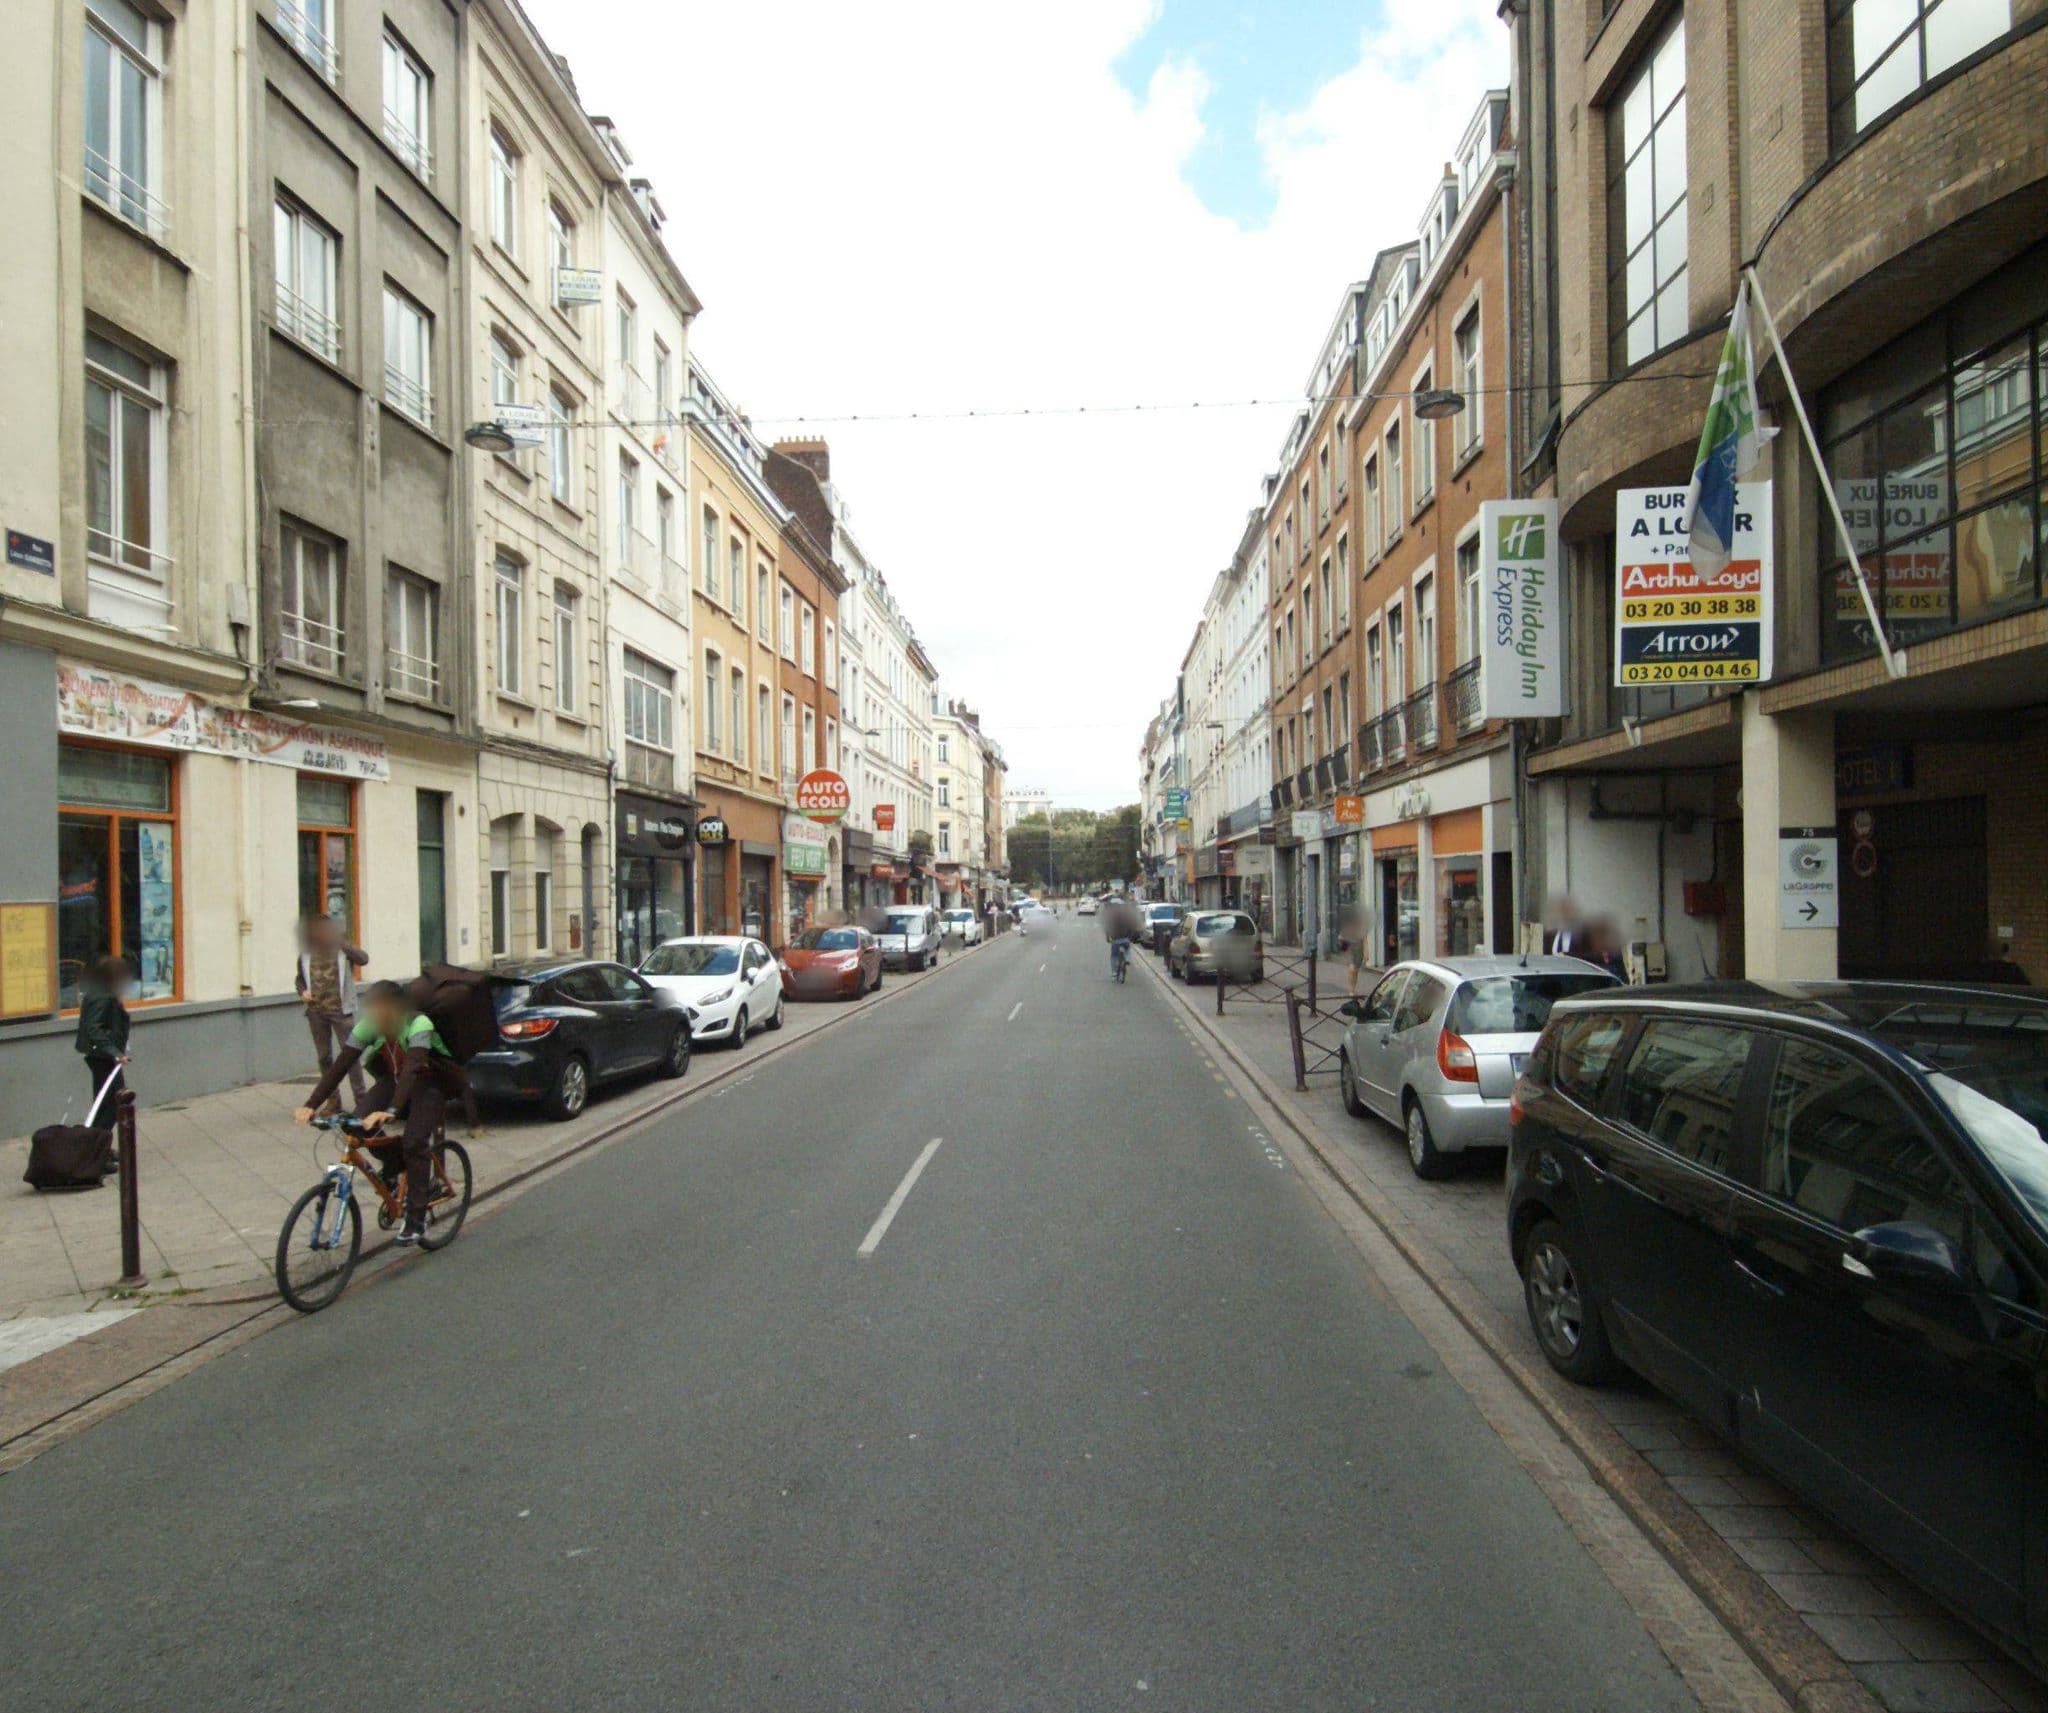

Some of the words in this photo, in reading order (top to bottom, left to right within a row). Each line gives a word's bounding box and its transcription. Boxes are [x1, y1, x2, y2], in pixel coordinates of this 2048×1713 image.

[1630, 518, 1649, 537] A
[1659, 513, 1753, 536] LOR
[1492, 566, 1517, 647] Express
[1515, 566, 1545, 658] Holiday
[1626, 603, 1647, 618] 03
[1653, 601, 1674, 617] 20
[1680, 600, 1702, 616] 30
[1707, 599, 1729, 615] 38
[1735, 598, 1756, 614] 38
[1641, 627, 1740, 653] Arrow
[1521, 661, 1545, 699] Inn
[1628, 666, 1648, 681] 03
[1653, 665, 1673, 680] 20
[1678, 664, 1699, 679] 04
[1703, 663, 1724, 678] 04
[1730, 662, 1751, 677] 46
[801, 781, 846, 795] AUTO
[799, 796, 847, 809] ECOLE
